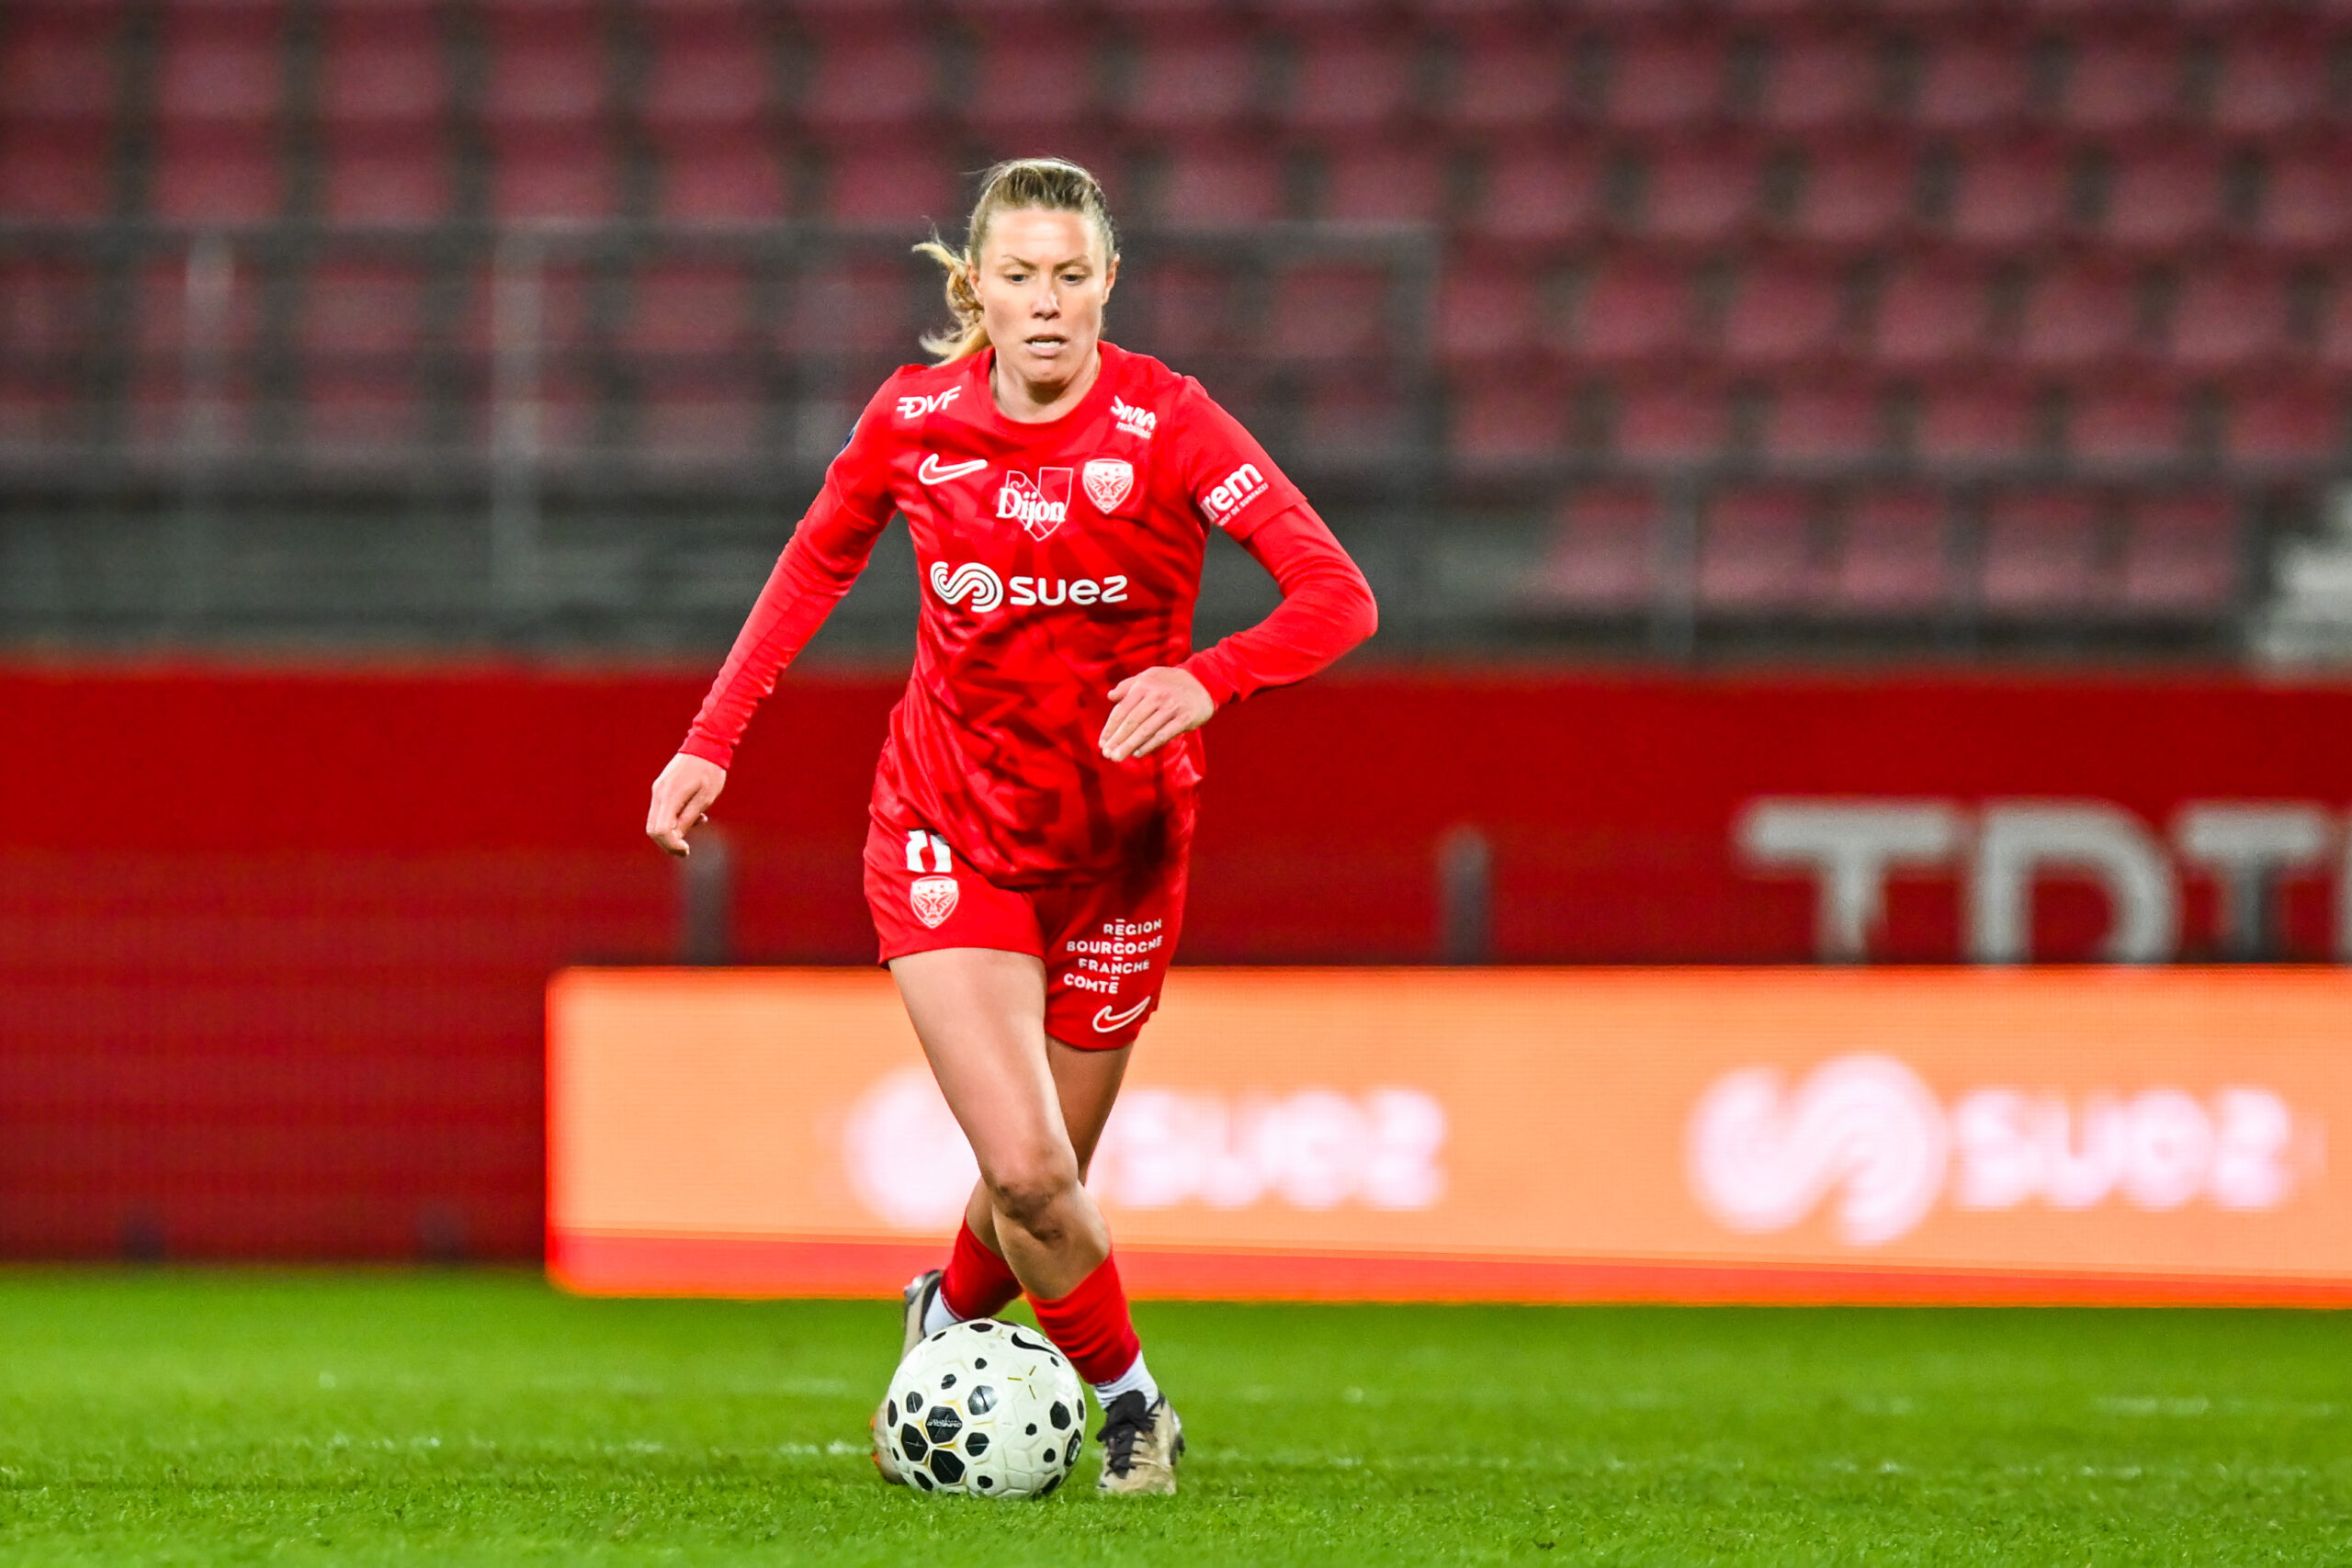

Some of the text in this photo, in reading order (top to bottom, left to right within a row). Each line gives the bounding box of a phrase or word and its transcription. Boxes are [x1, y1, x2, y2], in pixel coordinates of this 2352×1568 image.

[897, 385, 962, 419] DVF
[996, 487, 1066, 531] Dijon
[1067, 935, 1163, 954] BOURGOGNE
[1079, 957, 1150, 974] FRANCHE
